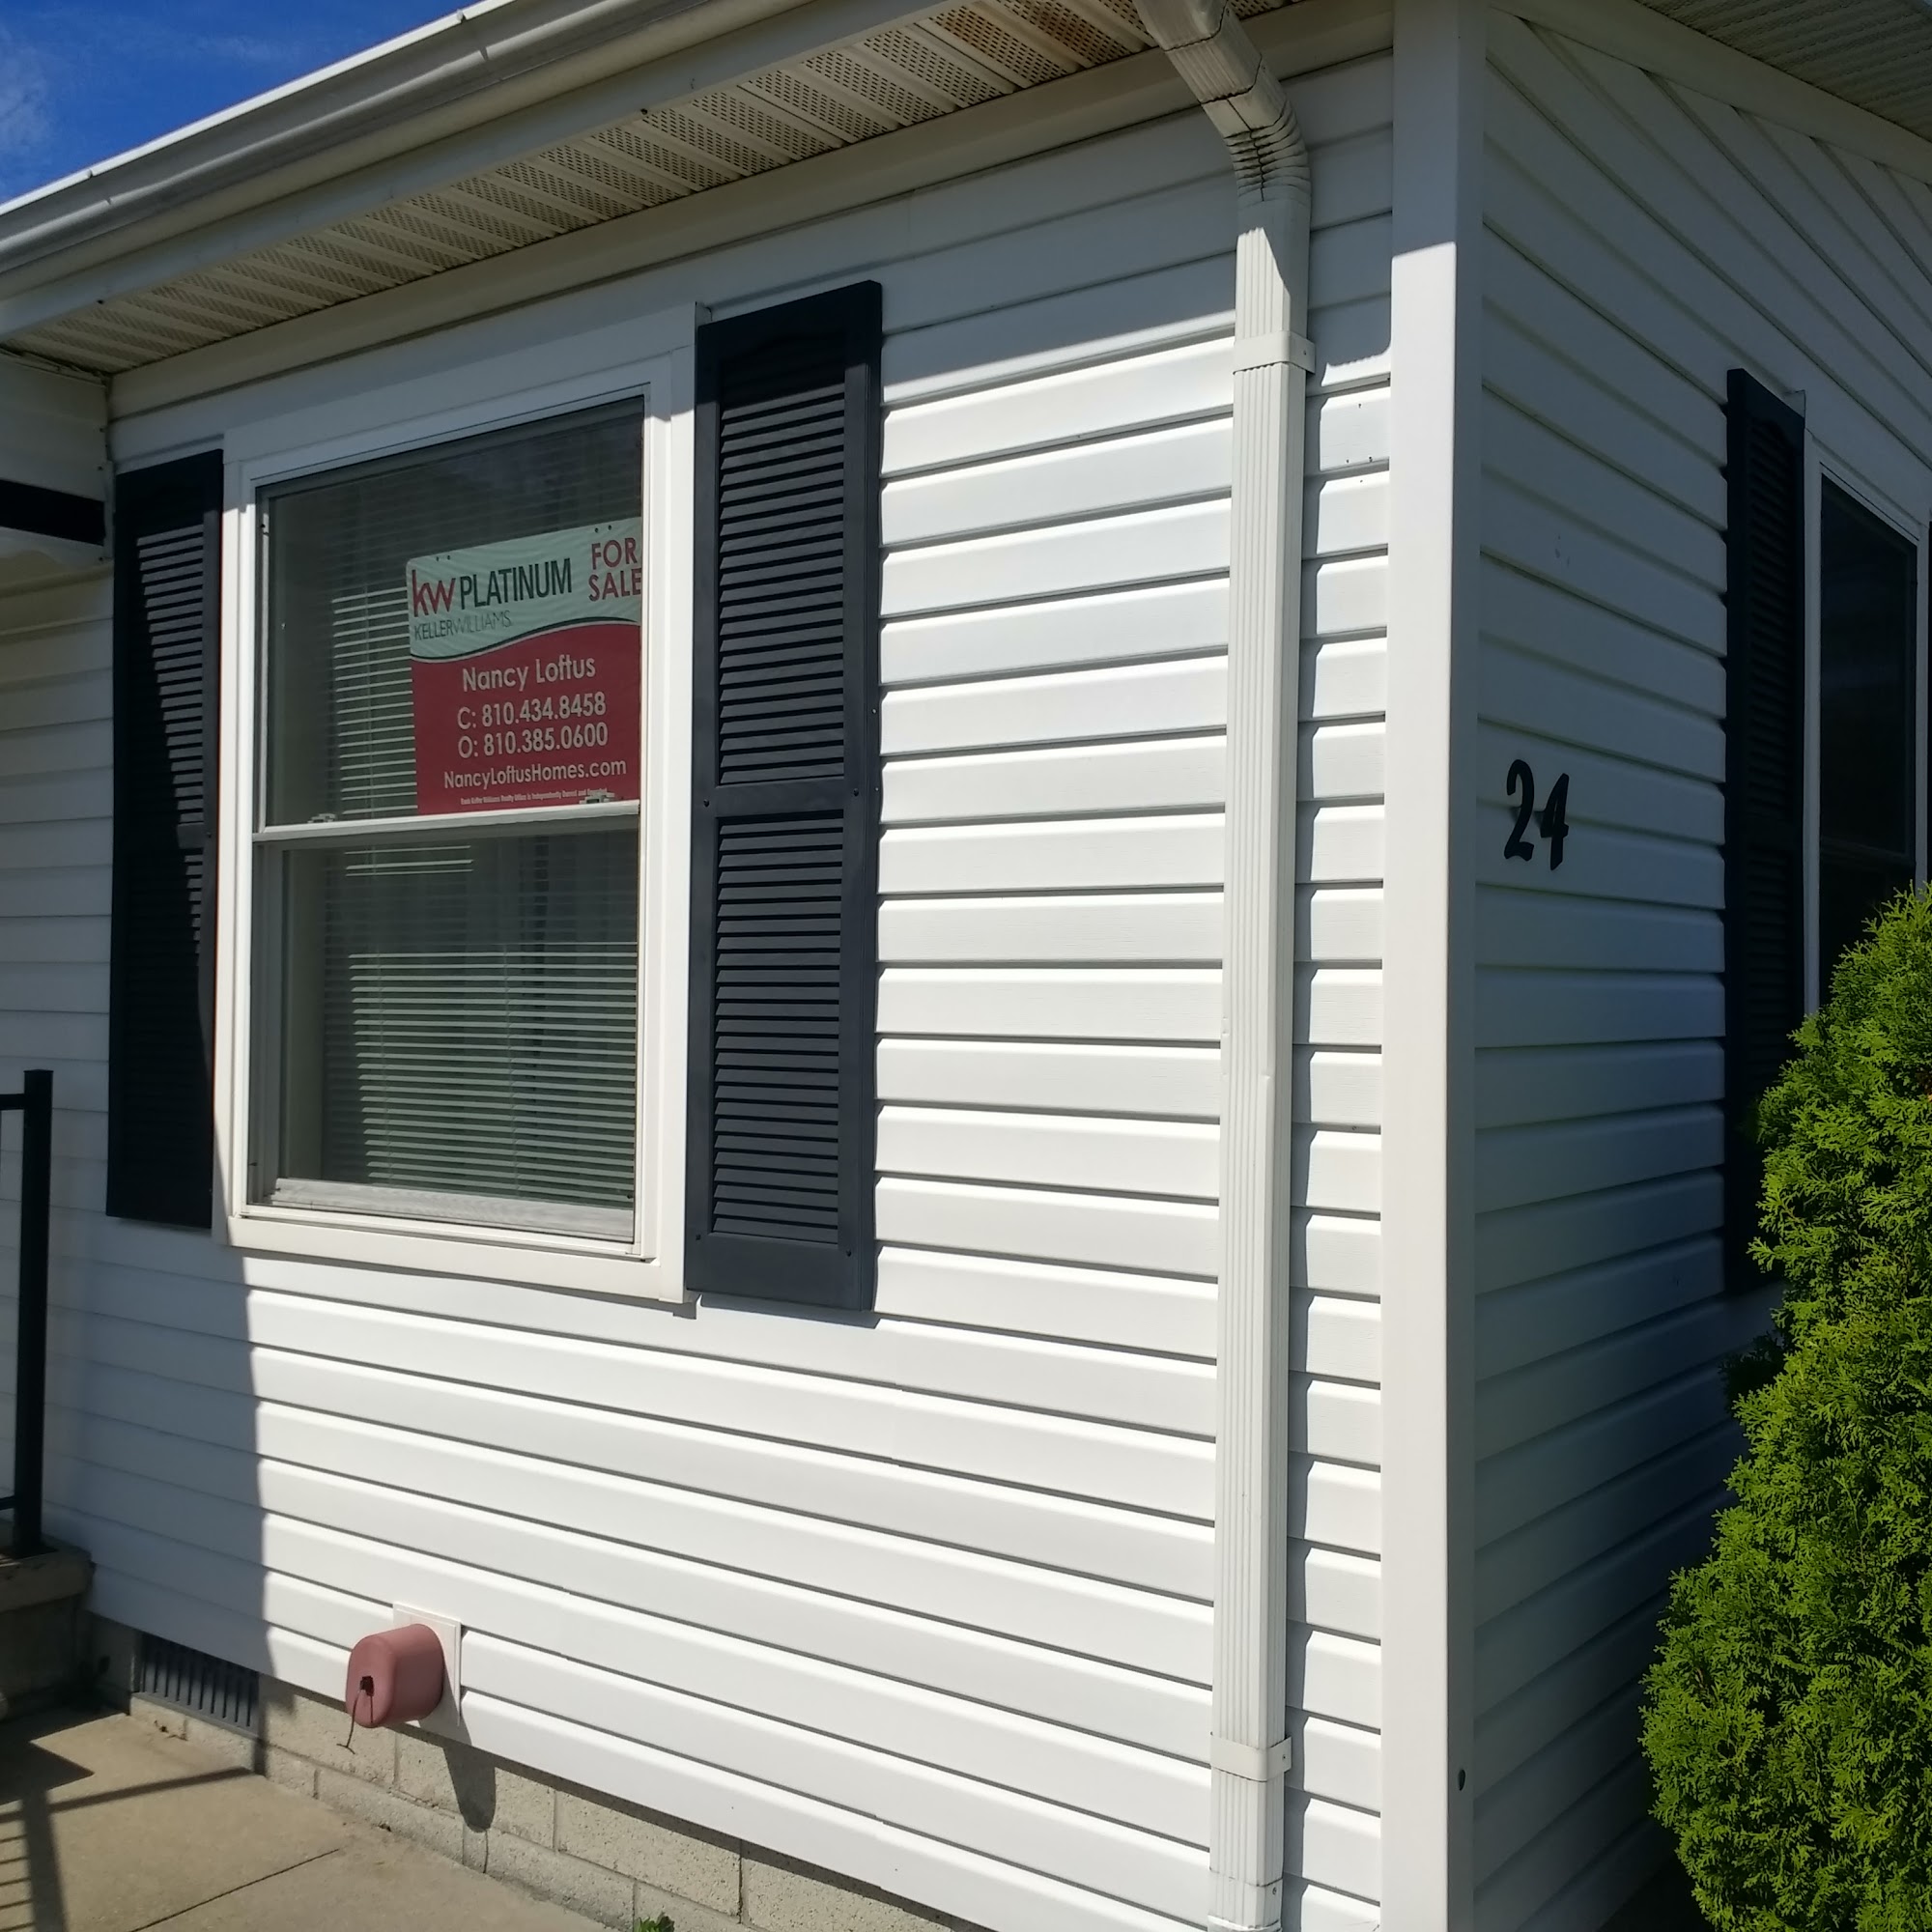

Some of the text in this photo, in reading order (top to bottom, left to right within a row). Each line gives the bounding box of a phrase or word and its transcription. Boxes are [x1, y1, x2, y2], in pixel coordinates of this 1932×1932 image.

[591, 537, 638, 570] FOR
[412, 557, 573, 617] kw PLATINUM
[588, 567, 641, 602] SALE
[463, 654, 596, 692] Nancy Loftus
[457, 692, 607, 729] C: 810.434.8458
[458, 722, 608, 758] O: 810.385.0600
[444, 760, 627, 789] NancyLoftusHomes.com
[1504, 759, 1569, 870] 24
